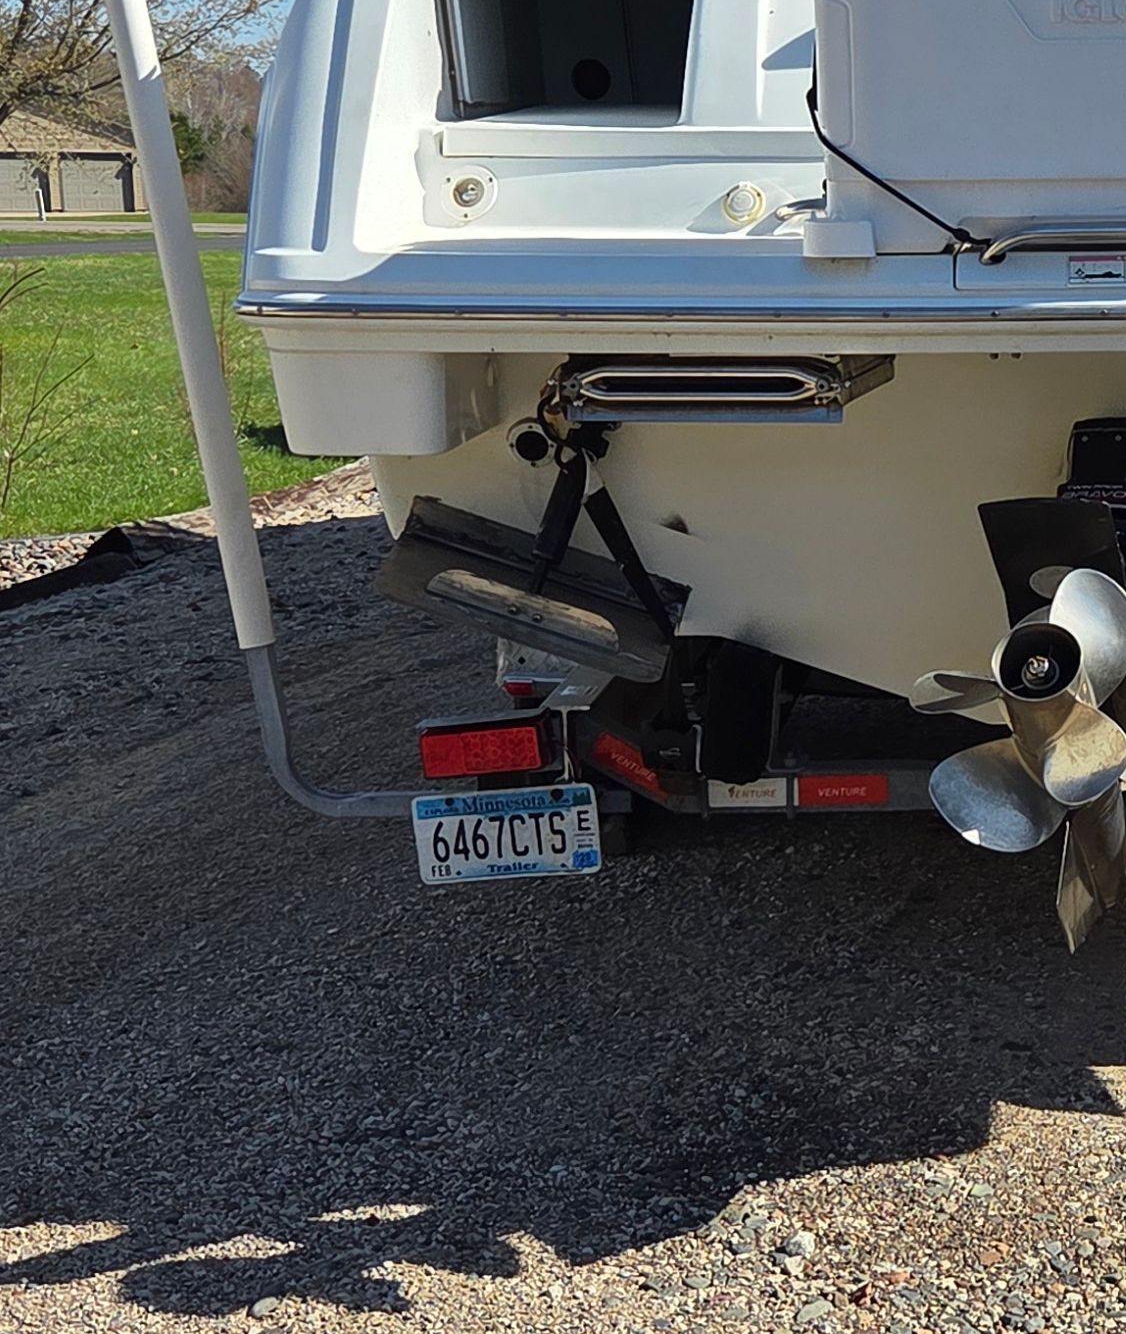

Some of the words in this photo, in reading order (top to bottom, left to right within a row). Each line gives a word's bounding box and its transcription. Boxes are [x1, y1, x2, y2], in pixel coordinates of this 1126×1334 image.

[610, 752, 657, 782] VENTURE
[817, 786, 868, 798] VENTURE
[462, 794, 546, 812] Minnesota
[576, 810, 592, 832] E
[432, 810, 567, 863] 6467CTS
[431, 864, 452, 878] FEB
[487, 862, 540, 873] Trailer
